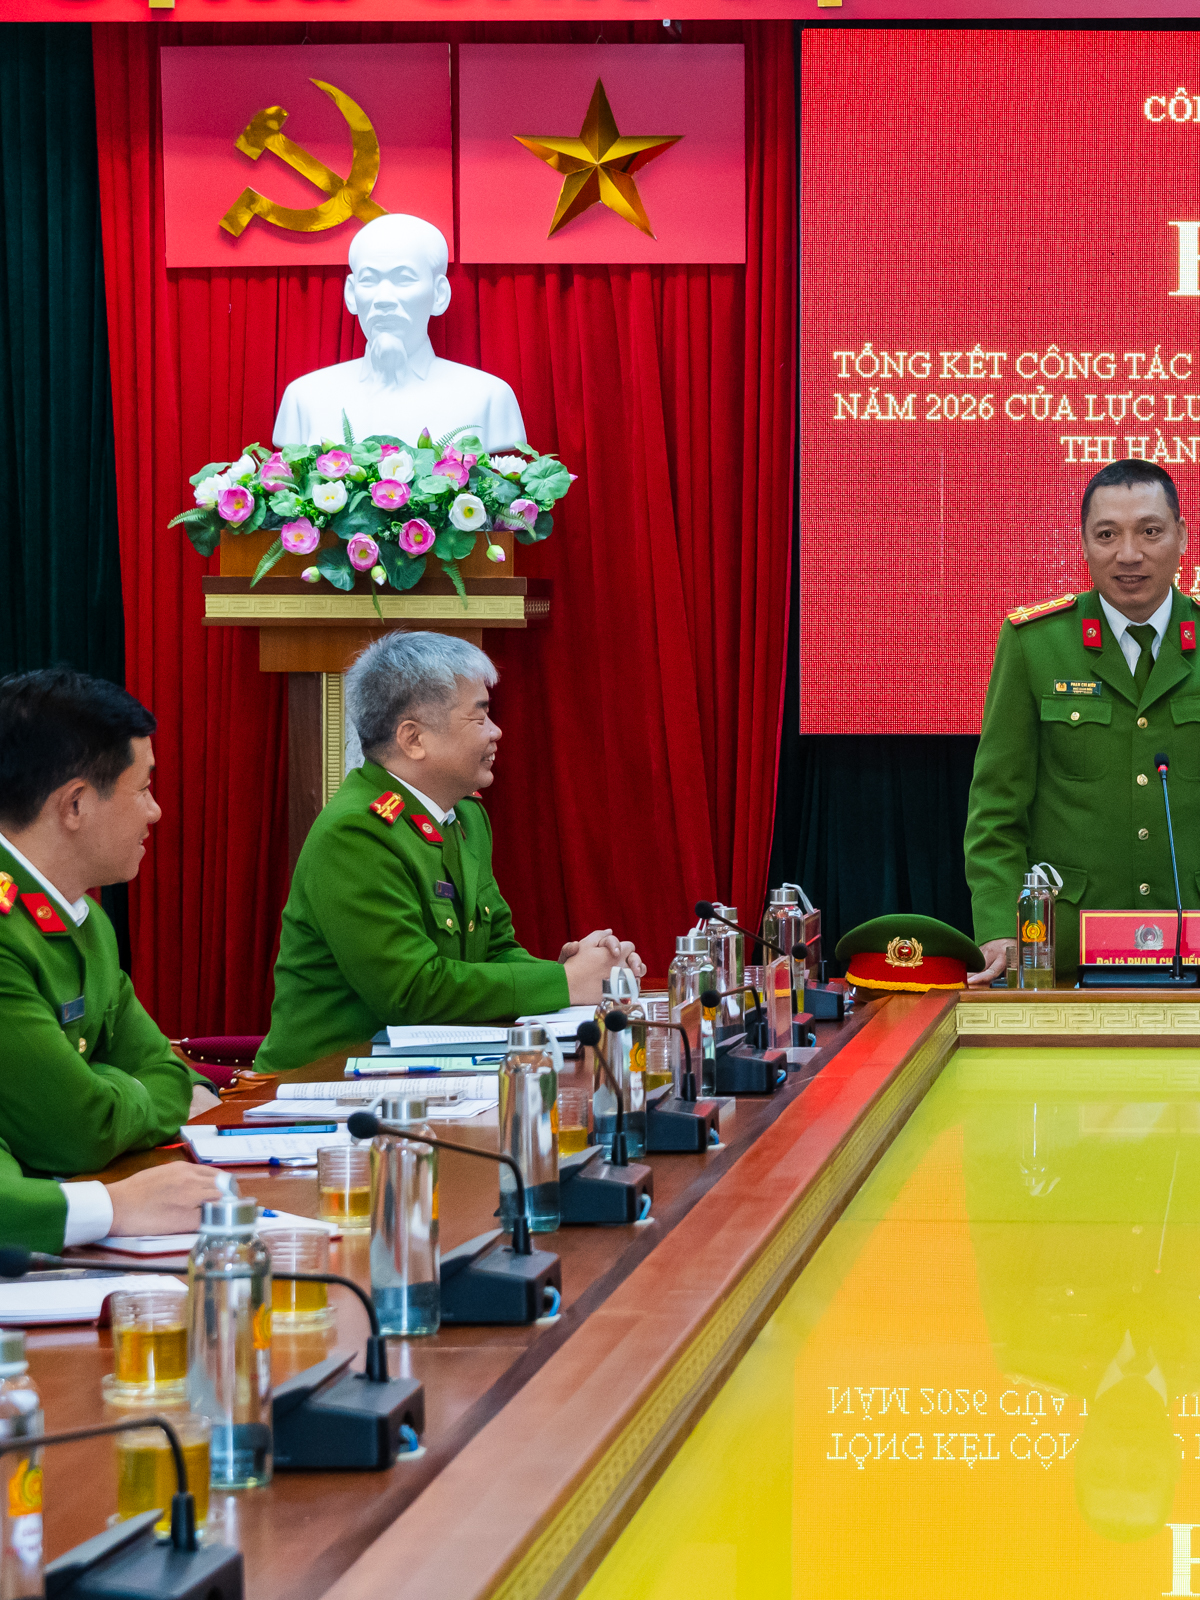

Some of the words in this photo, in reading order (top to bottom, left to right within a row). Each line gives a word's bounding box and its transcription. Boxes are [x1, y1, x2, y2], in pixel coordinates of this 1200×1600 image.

[833, 342, 932, 379] TỔNG
[939, 342, 1007, 379] KẾT
[1016, 343, 1117, 380] CÔNG
[1124, 344, 1193, 380] TÁC
[832, 386, 917, 421] NĂM
[925, 393, 994, 421] 2026
[1005, 384, 1078, 422] CỦA
[1084, 389, 1155, 427] LỰC
[1060, 435, 1117, 464] THI
